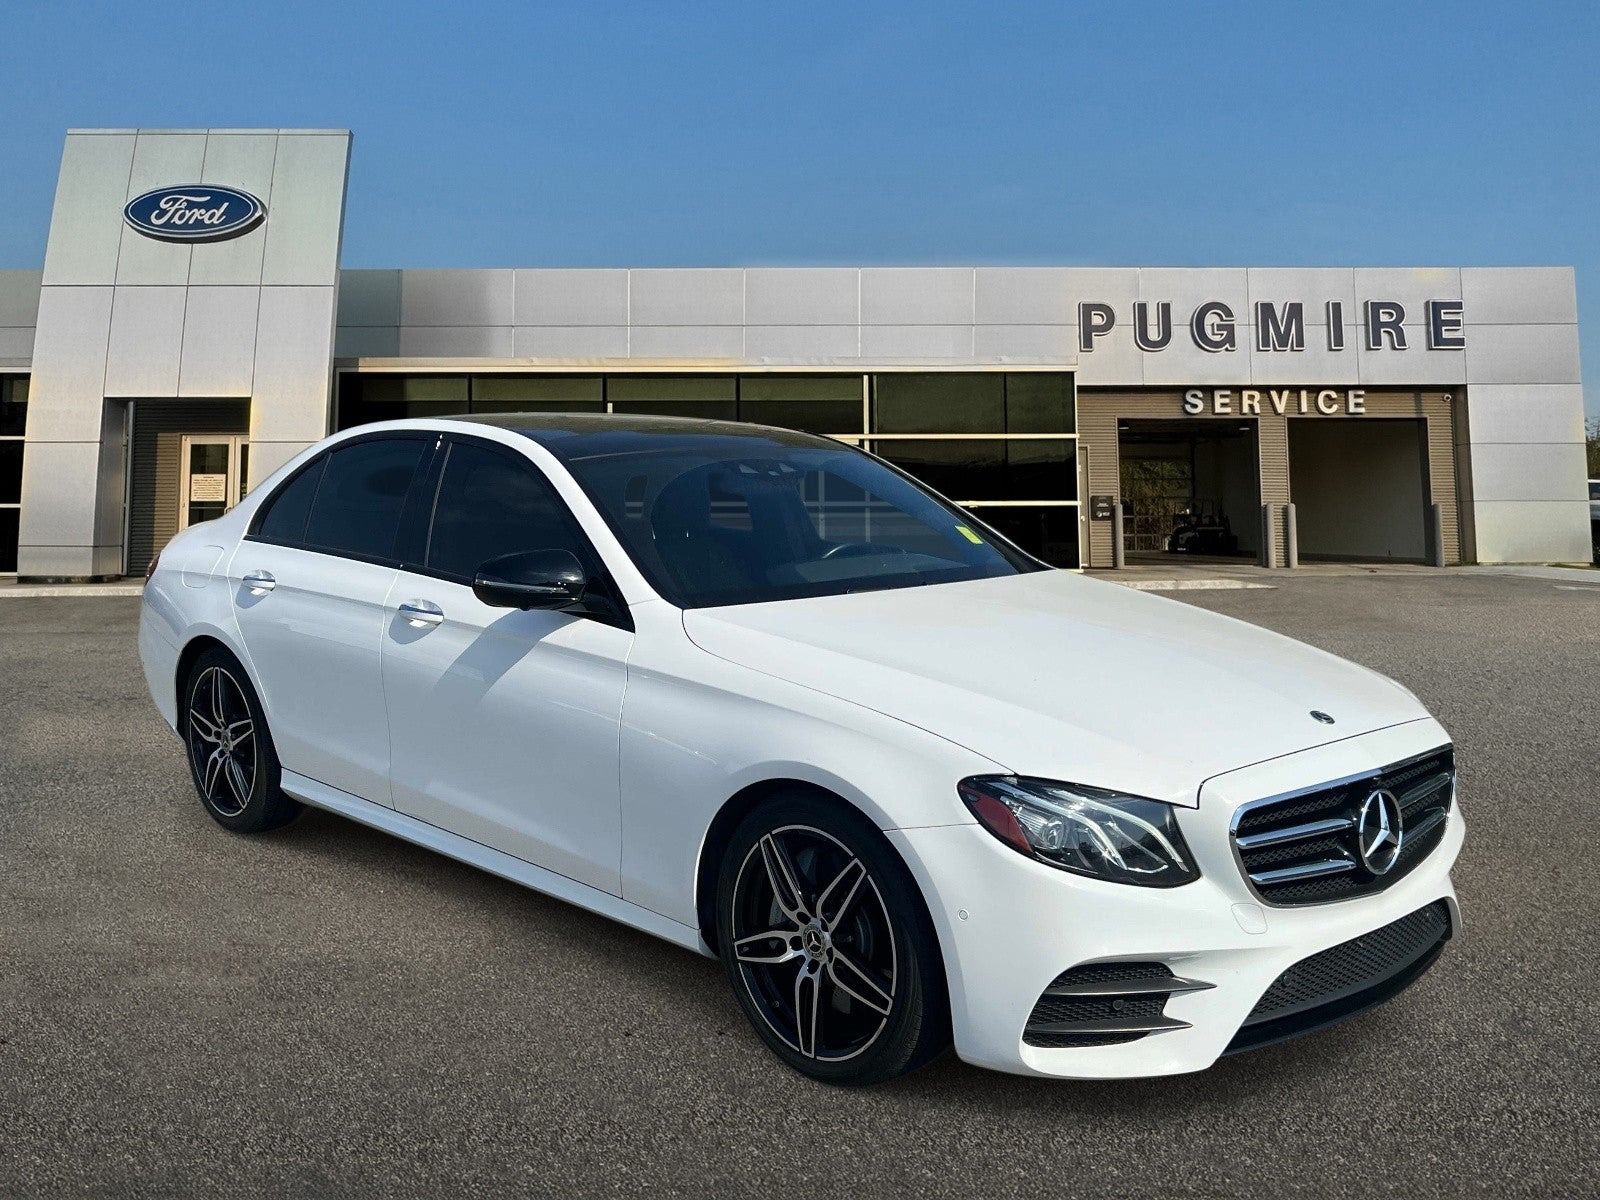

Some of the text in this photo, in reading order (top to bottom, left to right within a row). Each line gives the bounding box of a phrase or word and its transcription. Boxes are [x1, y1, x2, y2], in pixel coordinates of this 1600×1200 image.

[150, 194, 230, 225] Ford
[1078, 300, 1467, 352] PUGMIRE
[1183, 389, 1366, 415] SERVICE
